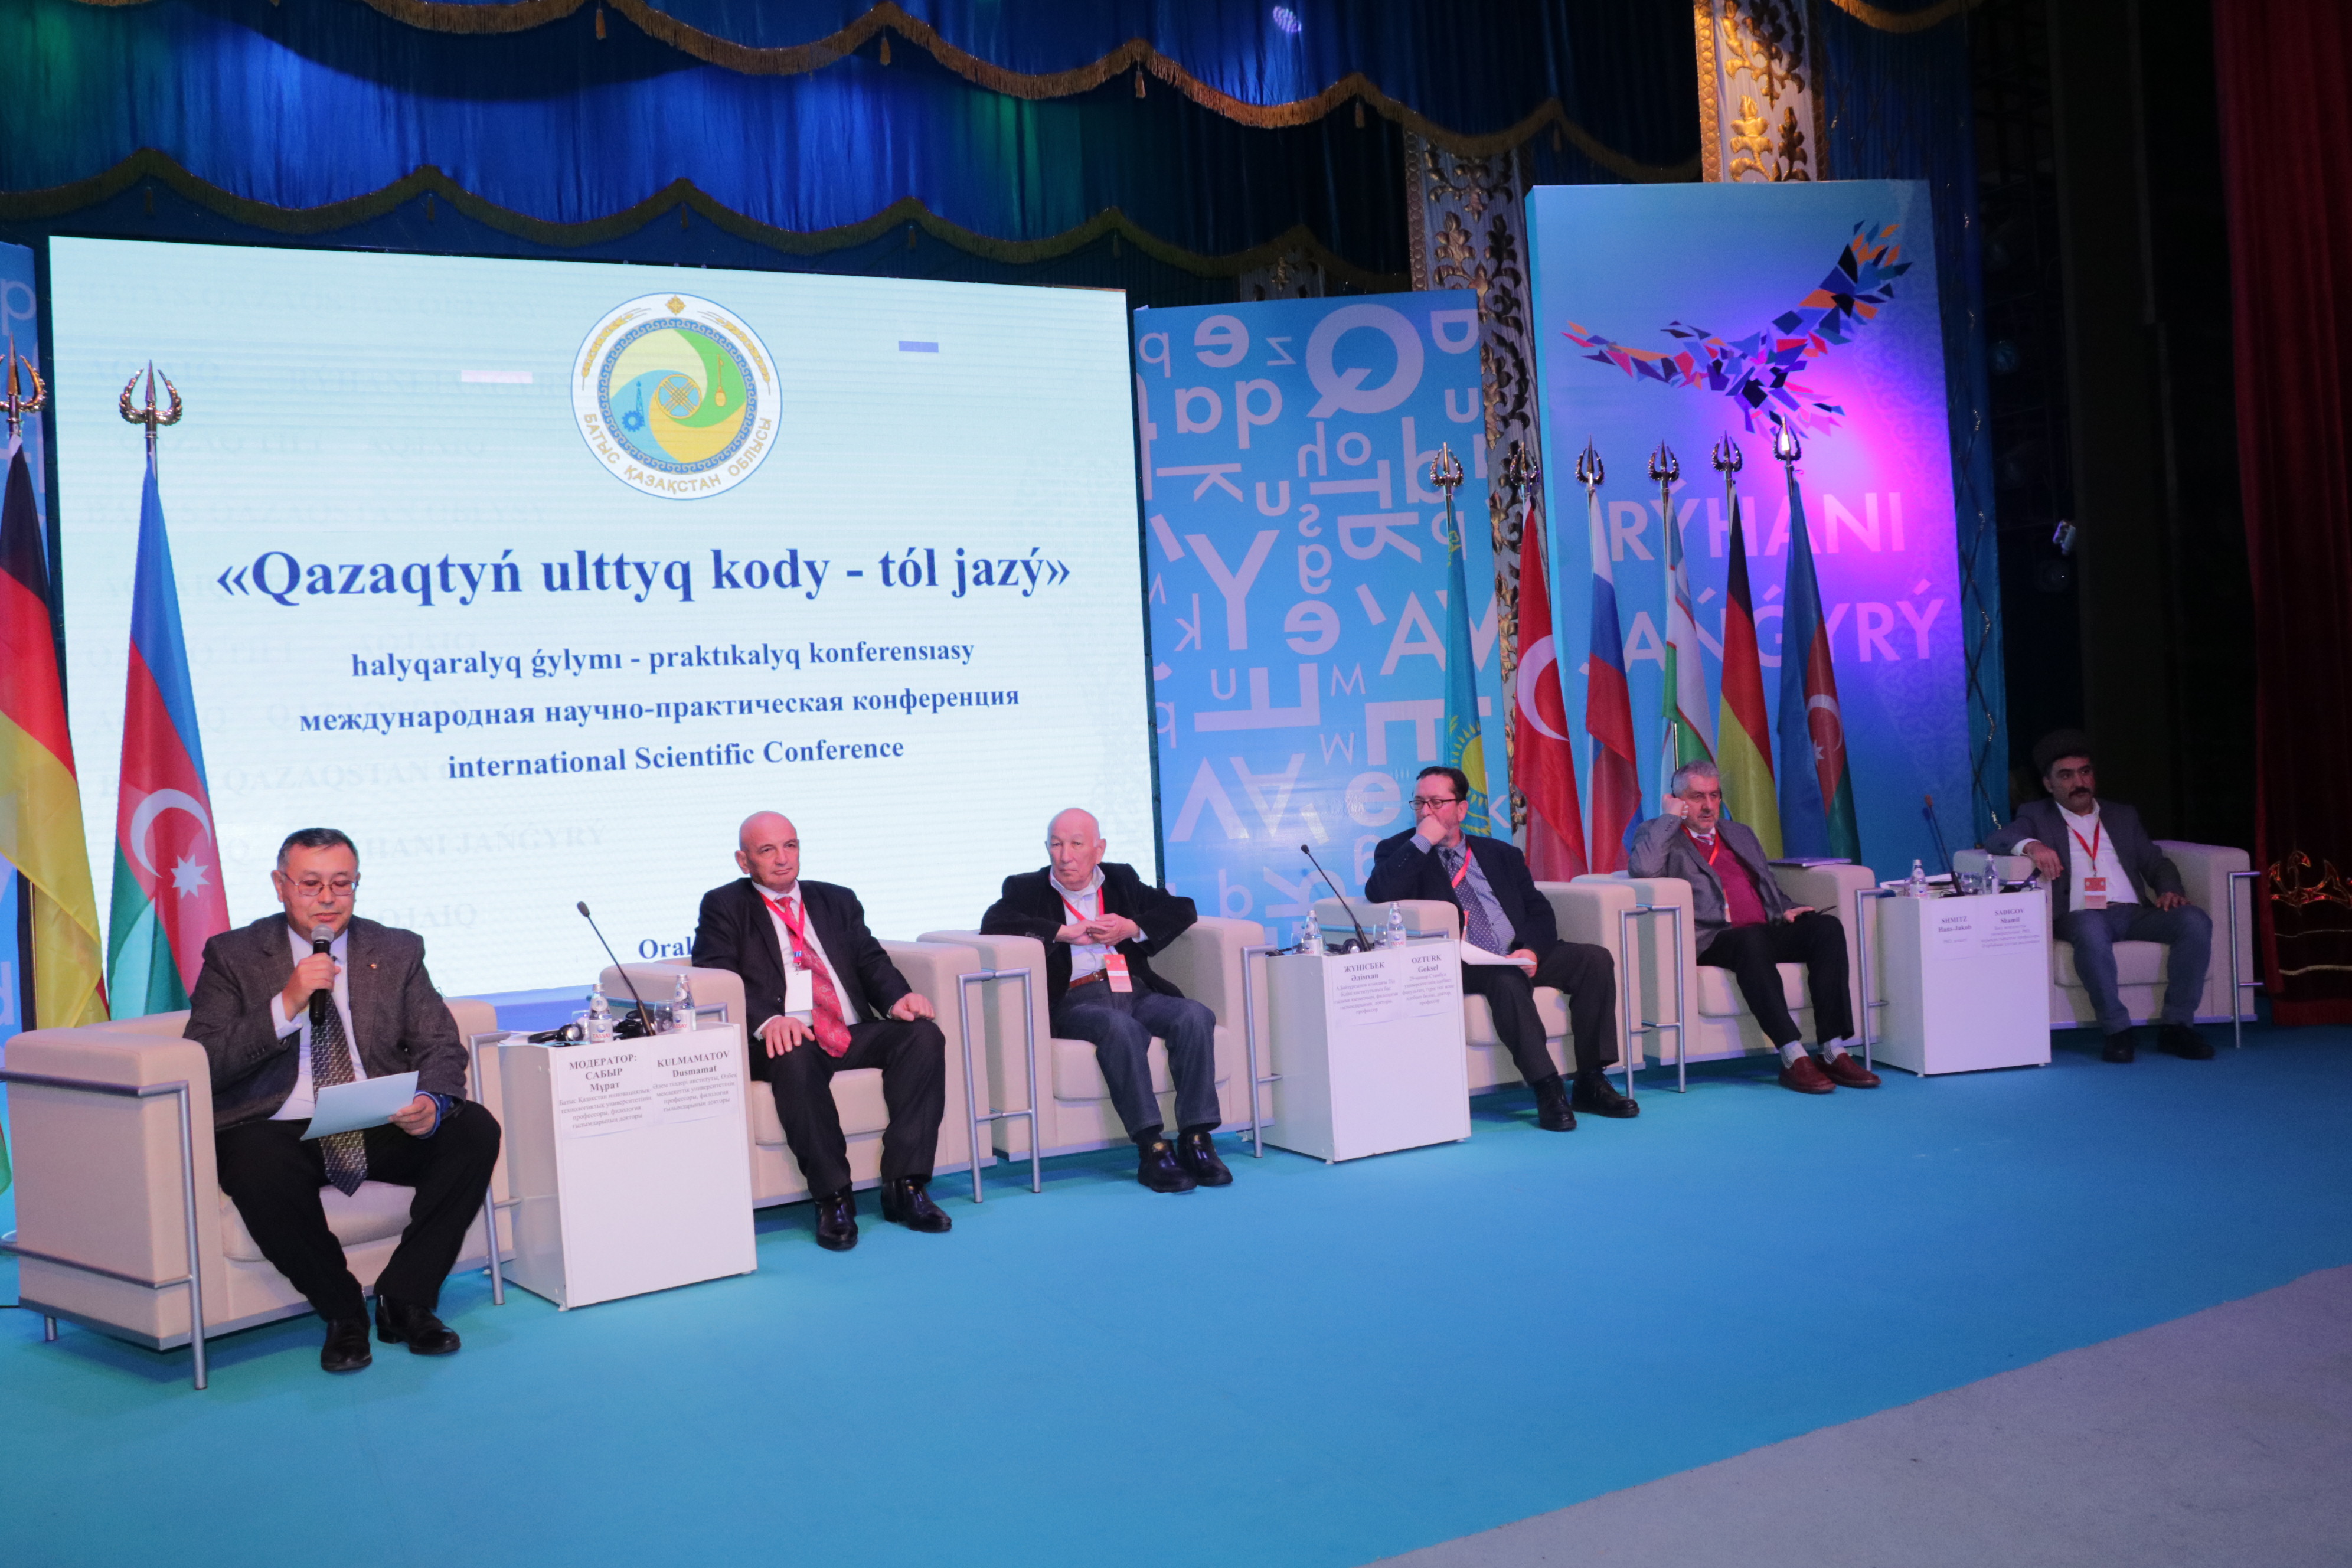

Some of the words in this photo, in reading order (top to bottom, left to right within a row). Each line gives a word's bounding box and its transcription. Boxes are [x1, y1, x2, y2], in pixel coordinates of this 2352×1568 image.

[583, 413, 620, 465] БАТЫС
[624, 465, 722, 495] ҚАЗАҚСТАН
[727, 417, 772, 476] ОБЛЫСЫ
[217, 548, 522, 607] «Qazaqtyń
[541, 549, 694, 603] ulttyq
[710, 548, 830, 600] kody
[878, 546, 938, 588] tól
[951, 546, 1070, 599] jazý»
[352, 650, 522, 682] halyqaralyq
[300, 707, 535, 737] международная
[545, 695, 844, 729] научно-практическая
[852, 687, 1020, 716] конференция
[449, 747, 626, 779] international
[635, 742, 755, 769] Scientific
[763, 738, 904, 764] Conference
[1938, 924, 1972, 933] Hans-Jakob
[639, 936, 691, 959] Oral
[1412, 954, 1442, 964] OZTURK
[1418, 964, 1438, 973] Goksel
[569, 1054, 638, 1070] МОДЕРАТОР:
[657, 1050, 730, 1068] KULMAMATOV
[586, 1068, 623, 1080] САБЫР
[672, 1065, 717, 1078] Dusmamat
[590, 1081, 620, 1092] Мұрат
